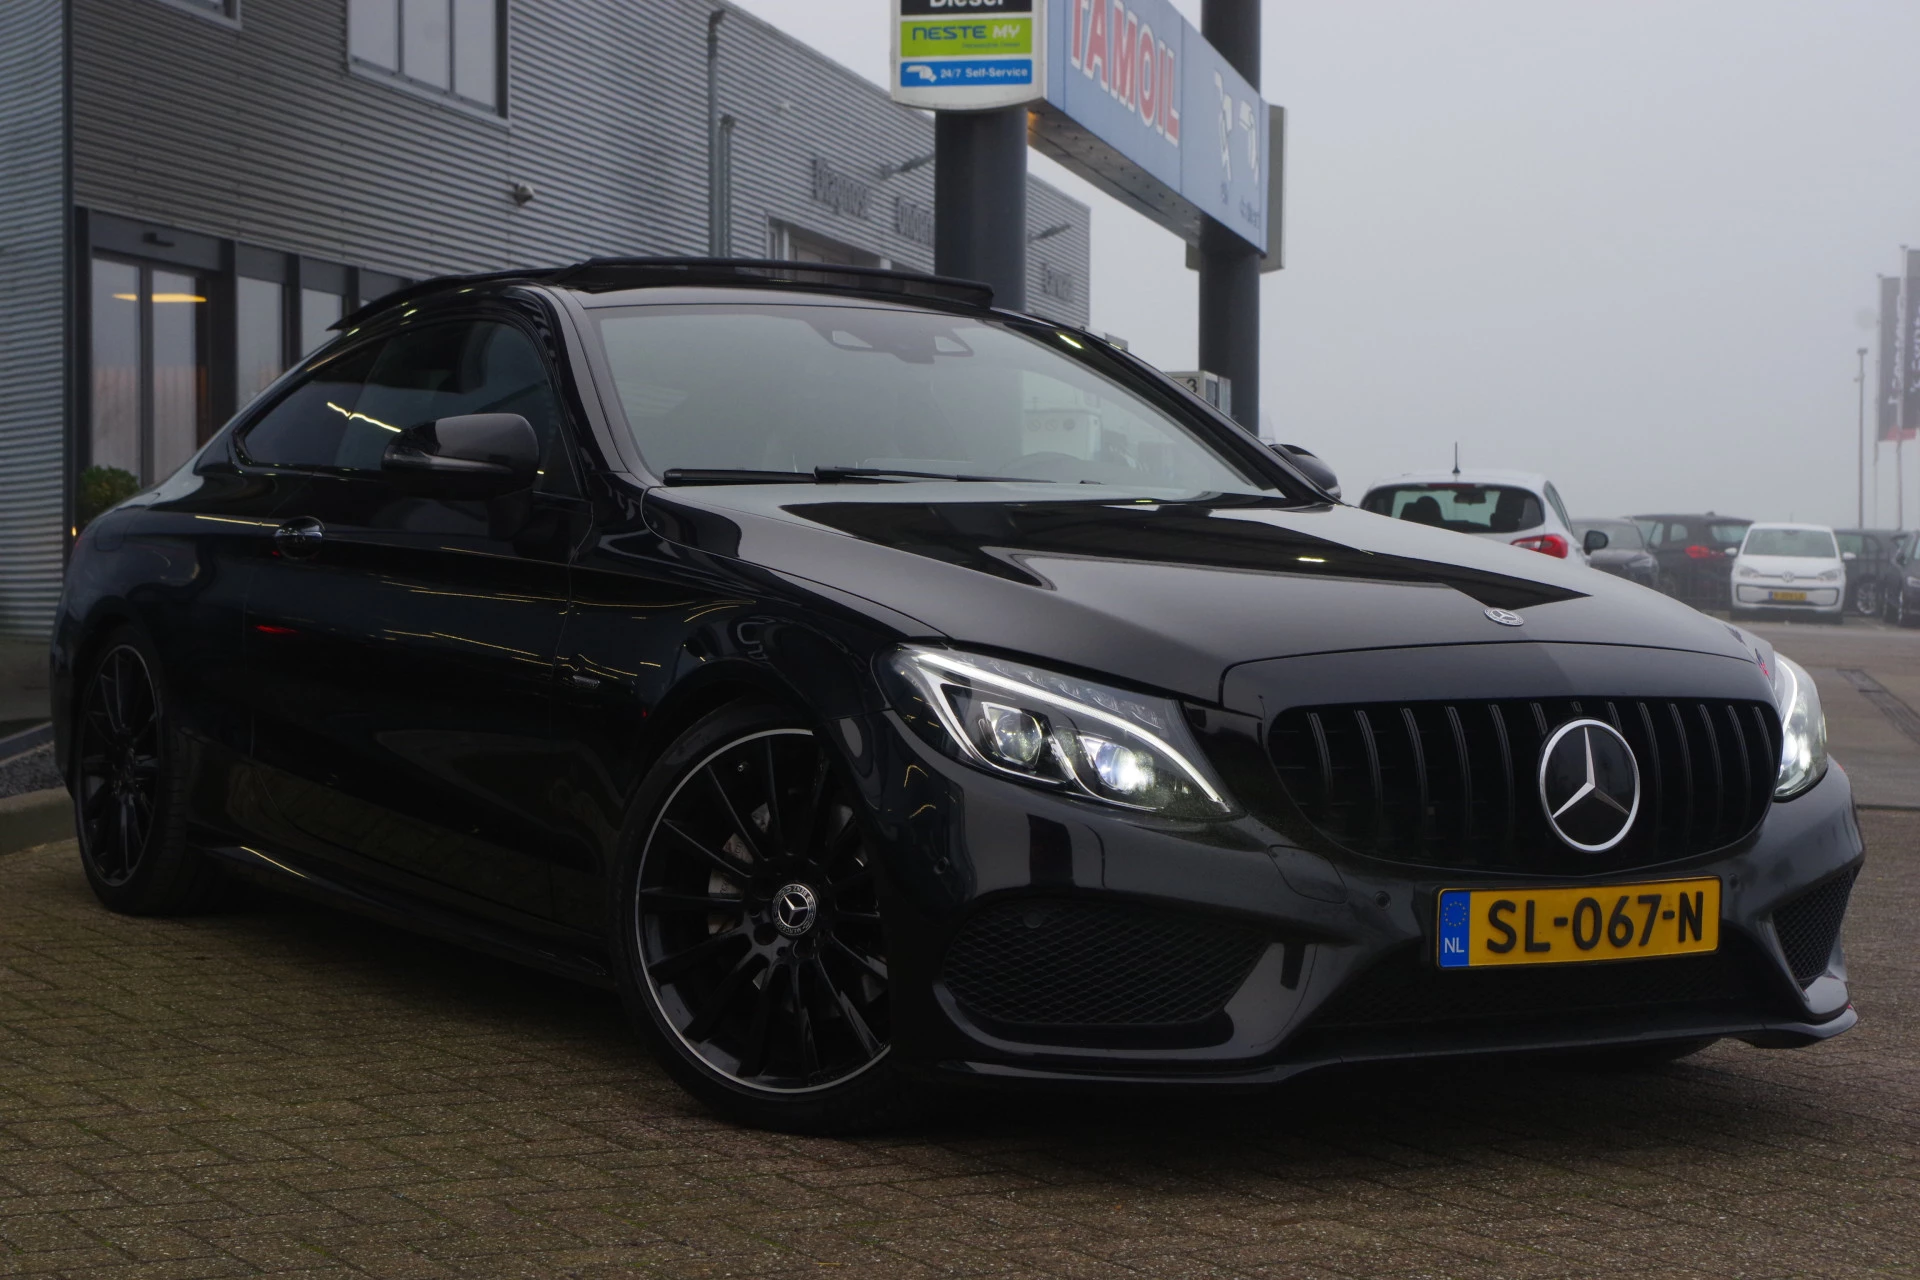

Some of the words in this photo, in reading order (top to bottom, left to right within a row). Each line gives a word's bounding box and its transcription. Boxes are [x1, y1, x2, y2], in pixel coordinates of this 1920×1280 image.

[912, 25, 988, 41] NESTE
[991, 24, 1020, 39] MY
[940, 67, 962, 79] 24/7
[965, 66, 1029, 79] Self-Service
[1186, 378, 1199, 394] 3
[1486, 891, 1705, 954] SL-067-N
[1443, 937, 1465, 954] NL
